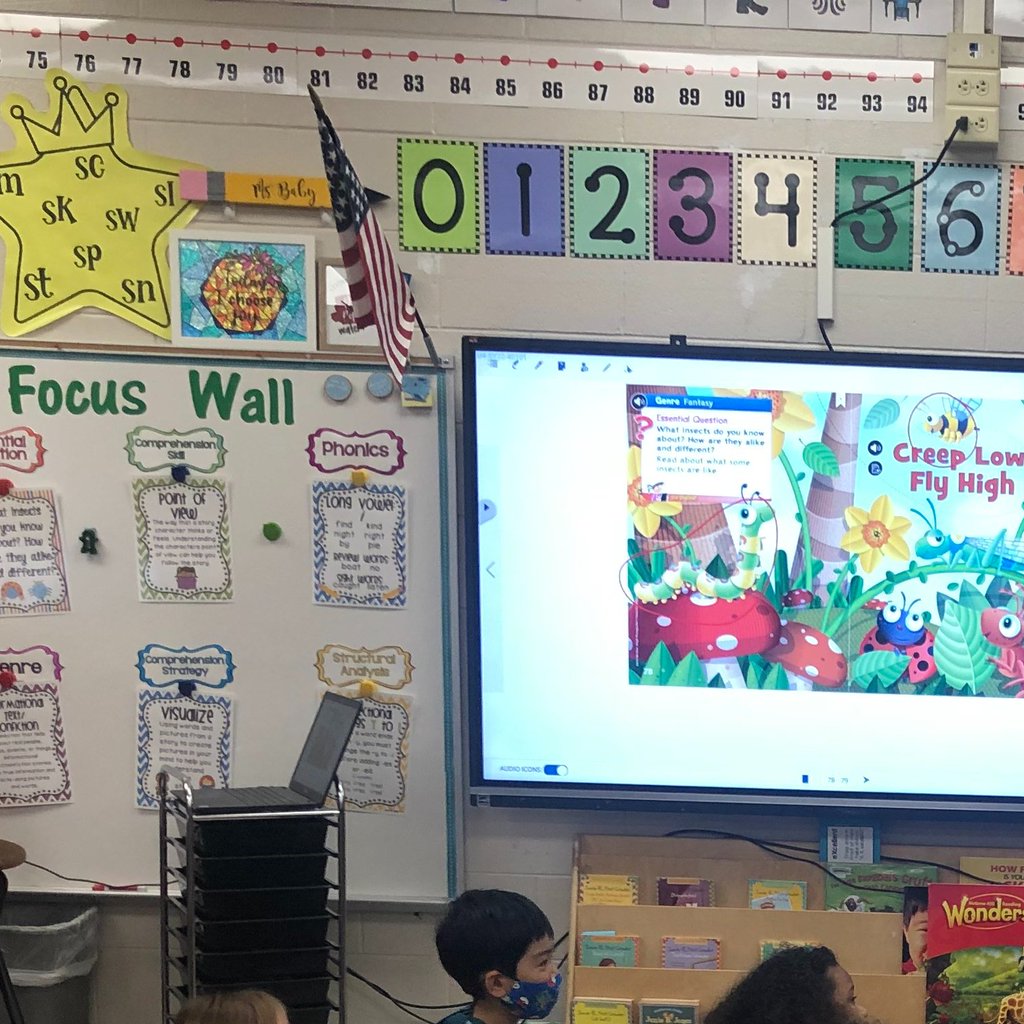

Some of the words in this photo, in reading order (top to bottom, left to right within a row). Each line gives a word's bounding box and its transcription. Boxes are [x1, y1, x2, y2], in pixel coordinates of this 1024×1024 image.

[26, 51, 48, 70] 75
[74, 54, 96, 73] 76
[121, 57, 142, 76] 77
[169, 60, 191, 79] 78
[216, 63, 238, 81] 79
[263, 66, 284, 84] 80
[310, 69, 331, 88] 81
[357, 72, 378, 90] 82
[403, 74, 425, 92] 83
[450, 76, 471, 95] 84
[496, 79, 517, 96] 85
[542, 82, 563, 99] 86
[588, 85, 608, 101] 87
[633, 87, 655, 104] 88
[679, 88, 700, 106] 89
[724, 90, 745, 108] 90
[771, 92, 791, 109] 91
[816, 93, 837, 111] 92
[862, 95, 882, 111] 93
[907, 96, 928, 113] 94
[75, 155, 105, 180] sc
[154, 181, 175, 207] sl
[277, 179, 315, 206] Baby
[413, 158, 464, 233] 0
[516, 163, 532, 236] 1
[585, 165, 635, 244] 2
[668, 167, 716, 245] 3
[754, 172, 799, 247] 4
[850, 175, 899, 252] 5
[938, 181, 985, 257] 6
[106, 208, 139, 232] sw
[73, 245, 102, 270] sp
[24, 268, 53, 300] st
[122, 278, 156, 303] sn
[8, 365, 146, 416] Focus
[189, 370, 294, 425] Wall
[655, 396, 680, 406] Genre
[684, 398, 714, 408] Fantasy
[657, 414, 690, 423] Essential
[693, 415, 728, 424] Question
[727, 429, 740, 437] you
[743, 428, 765, 436] know
[135, 439, 216, 449] Comprehension
[724, 438, 741, 446] they
[168, 451, 185, 459] Skill
[322, 441, 389, 457] Phonics
[893, 443, 966, 471] Creep
[910, 471, 948, 500] Fly
[958, 472, 1015, 501] High
[24, 537, 43, 546] How
[6, 552, 28, 565] they
[145, 656, 225, 665] Comprehension
[333, 653, 396, 665] Structural
[162, 667, 209, 677] Strategy
[340, 667, 390, 678] Analysis
[990, 865, 1017, 873] HOW
